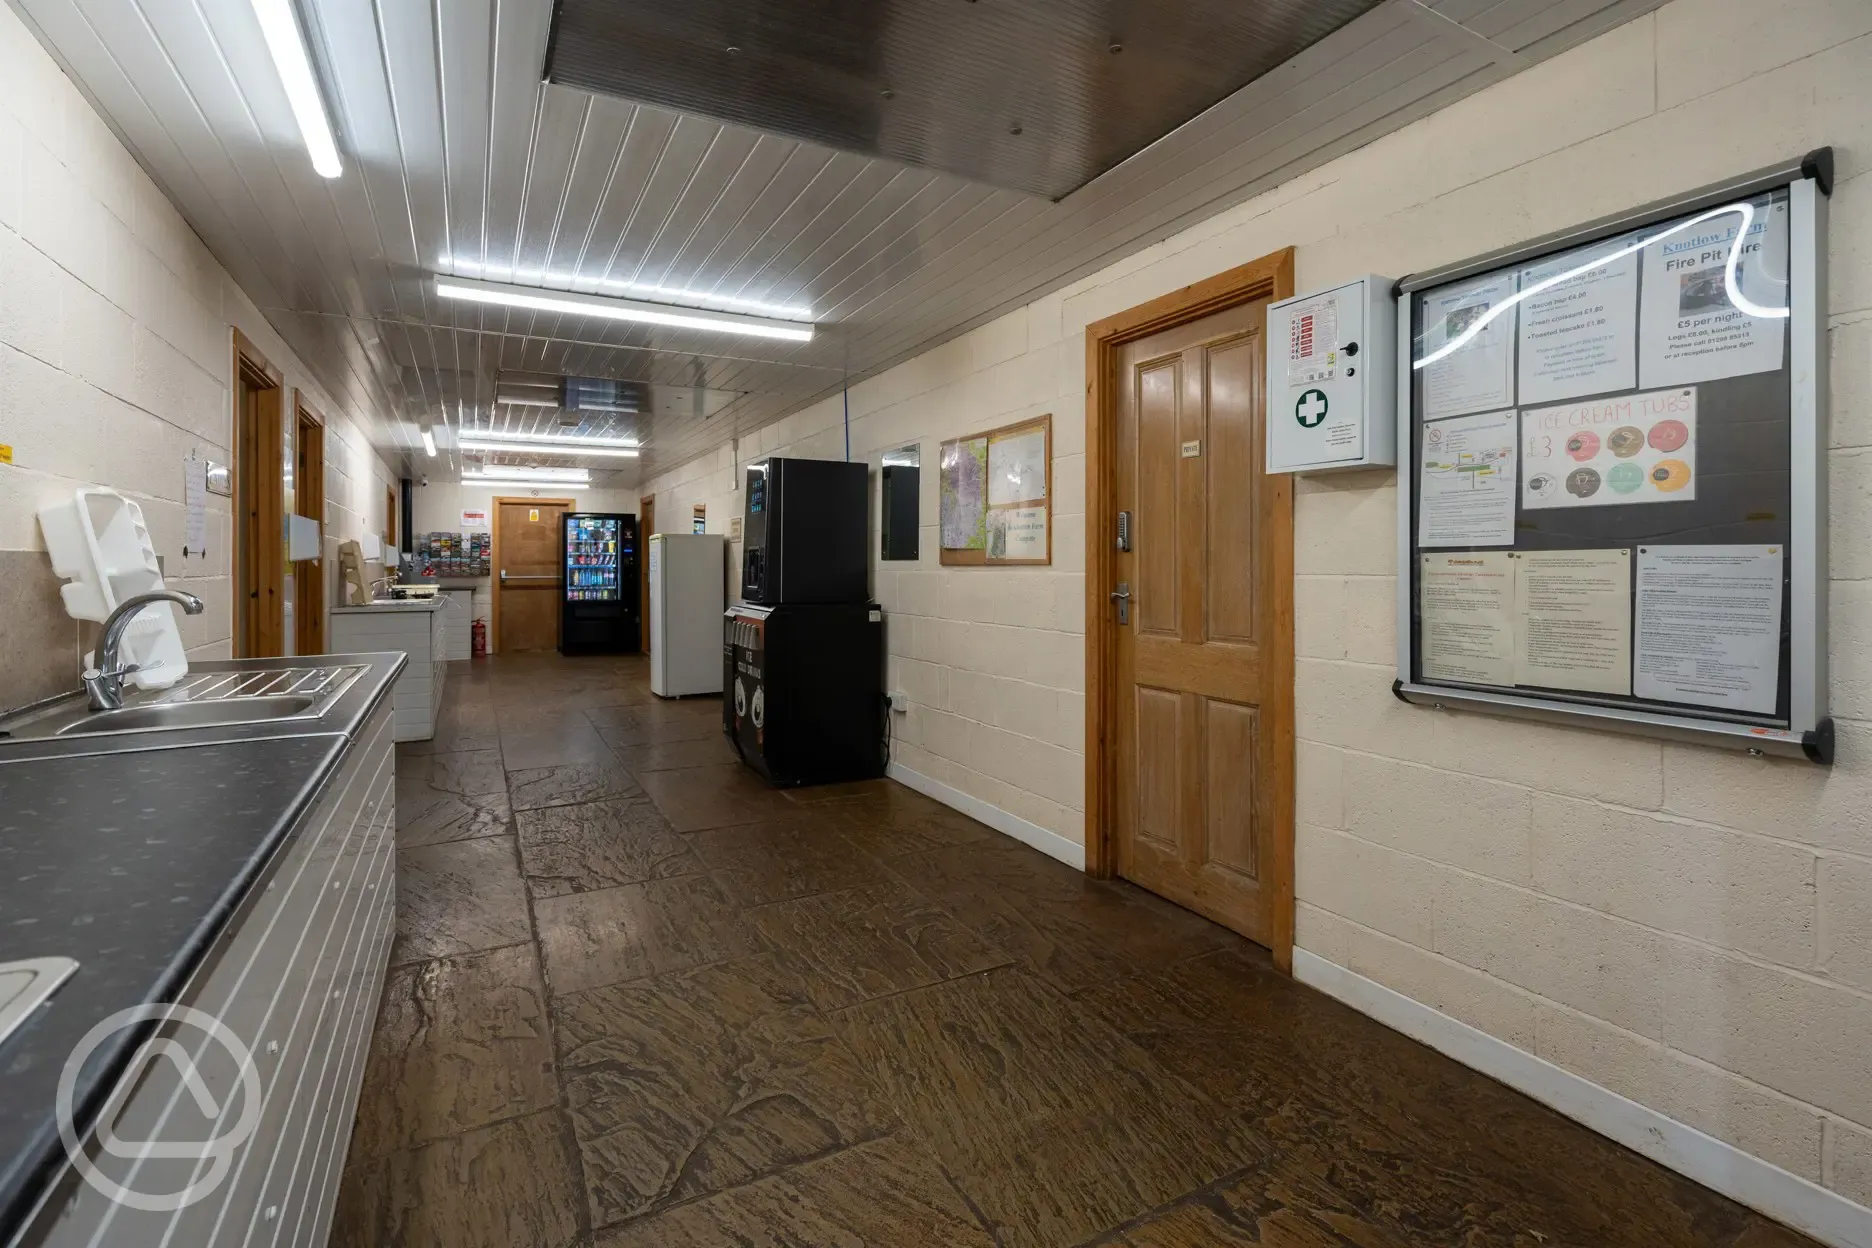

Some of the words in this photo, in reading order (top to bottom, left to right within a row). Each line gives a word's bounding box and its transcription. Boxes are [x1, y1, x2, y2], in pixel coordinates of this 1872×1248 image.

[1727, 223, 1767, 238] Fm
[1666, 258, 1696, 272] Fire
[1701, 250, 1722, 264] Pit
[1531, 300, 1553, 310] Bacon
[1531, 318, 1550, 327] Fresh
[1552, 310, 1583, 322] croissant
[1677, 320, 1691, 328] £5
[1694, 317, 1711, 328] per
[1714, 311, 1743, 323] night
[1531, 329, 1558, 339] Toasted
[1558, 323, 1585, 334] teacake
[1712, 324, 1741, 334] kindling
[1669, 342, 1692, 350] Please
[1682, 347, 1714, 357] reception
[1716, 344, 1738, 352] before
[1538, 411, 1565, 430] ICE
[1568, 402, 1631, 428] CREAM
[1638, 394, 1690, 416] TUBS
